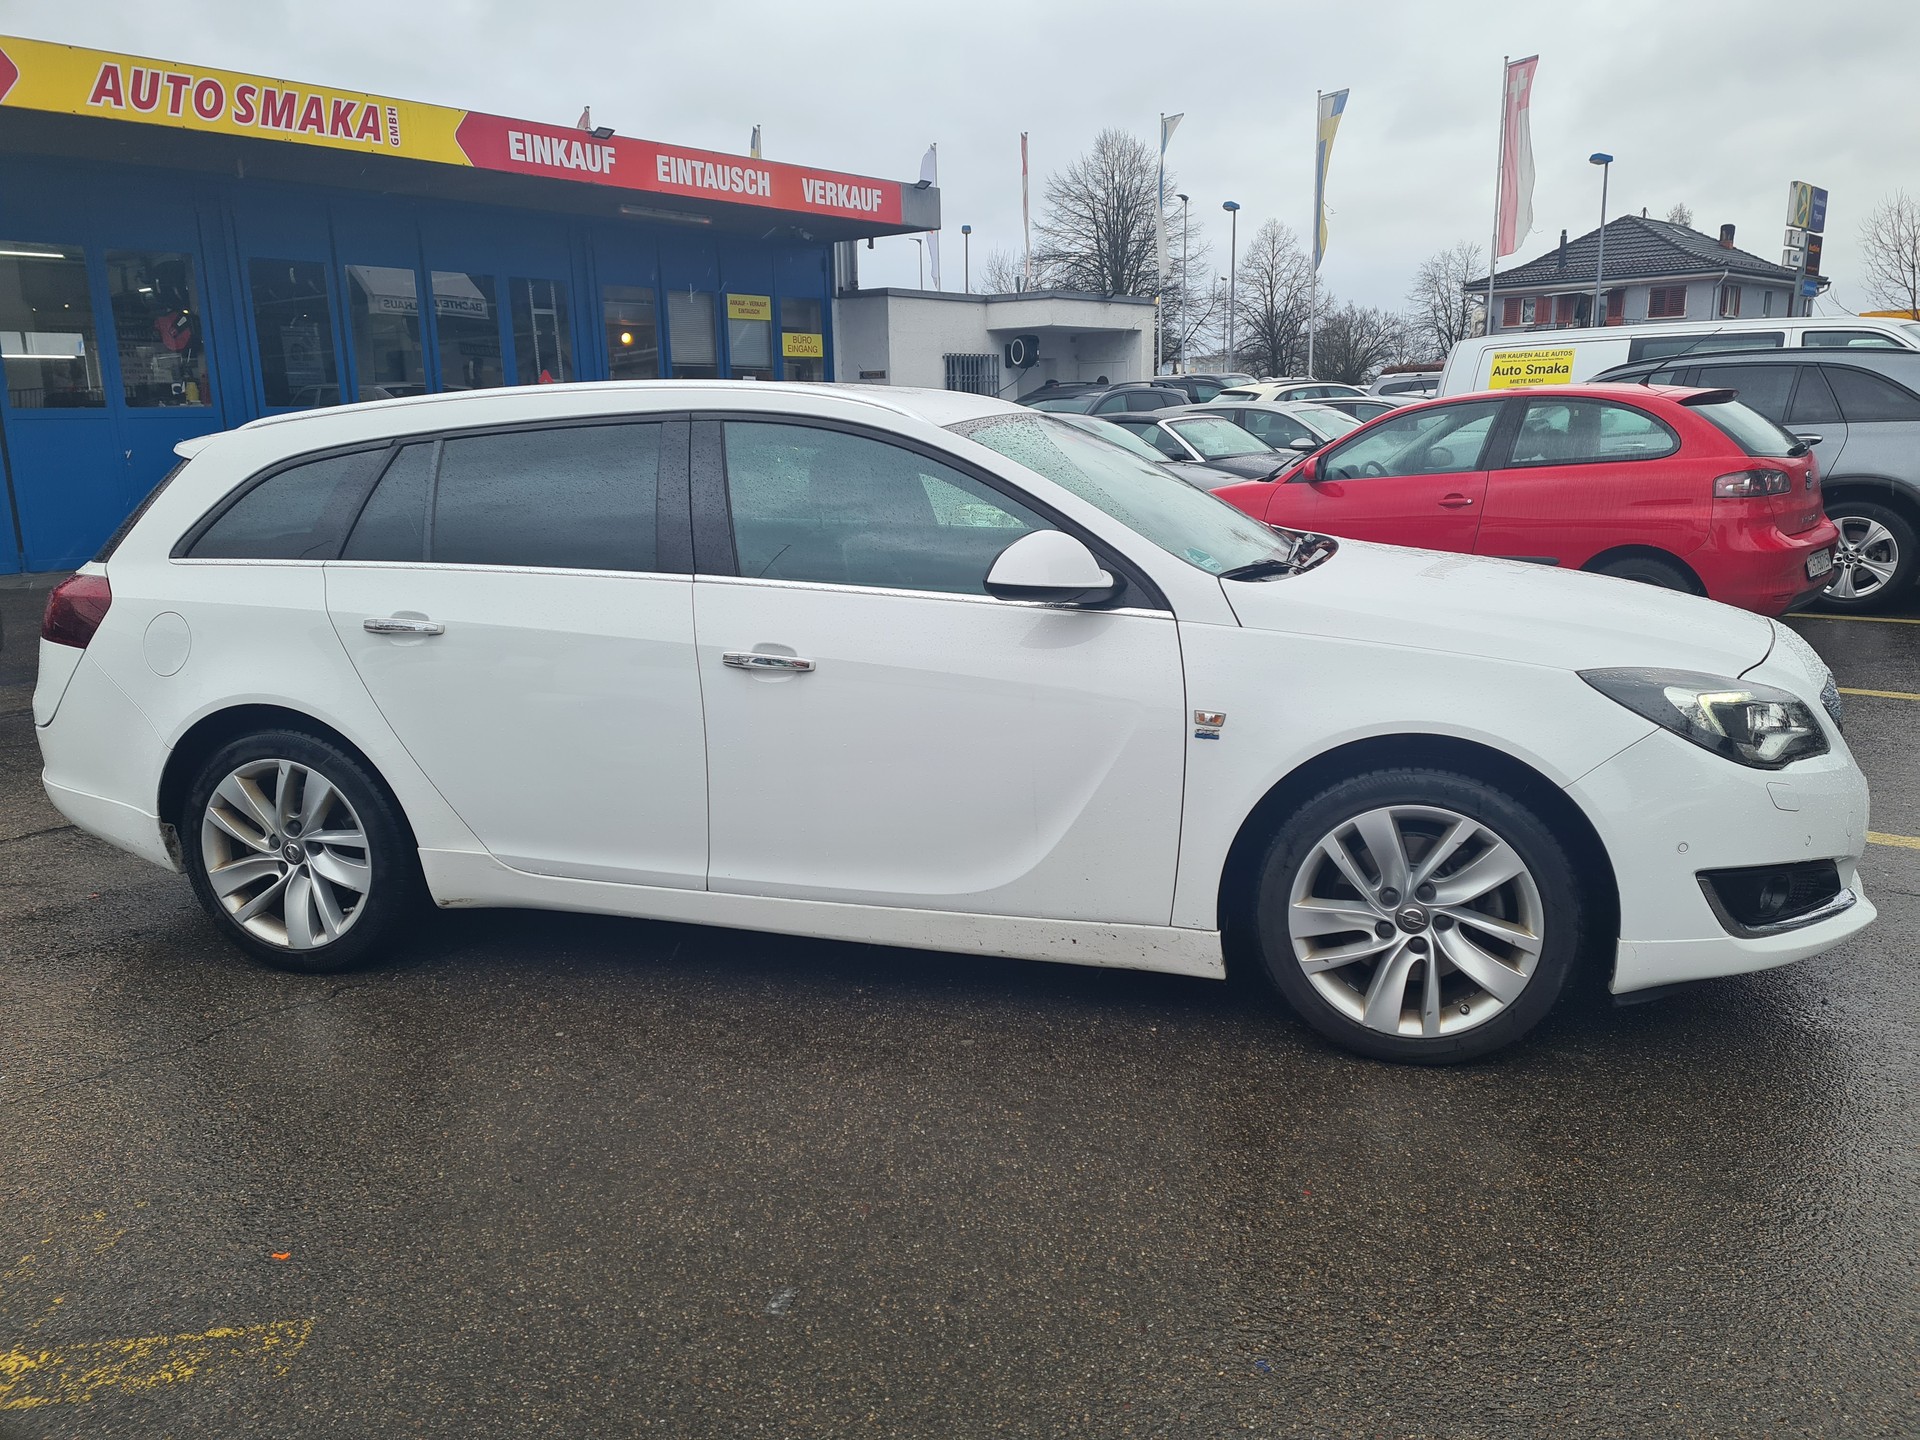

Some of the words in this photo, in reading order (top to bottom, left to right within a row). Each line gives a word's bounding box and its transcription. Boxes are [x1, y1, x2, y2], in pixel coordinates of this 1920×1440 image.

[87, 62, 226, 121] AUTO
[232, 83, 383, 144] SMAKA
[386, 106, 400, 147] GMBH
[508, 130, 616, 174] EINKAUF
[656, 154, 771, 197] EINTAUSCH
[801, 177, 882, 212] VERKAUF
[729, 299, 746, 307] ANKAUF
[749, 300, 767, 308] VERKAUF
[738, 307, 760, 315] EINTAUSCH
[792, 335, 812, 345] BÜRO
[787, 344, 818, 354] EINGANG
[1492, 365, 1522, 376] Auto
[1525, 362, 1569, 375] Smaka
